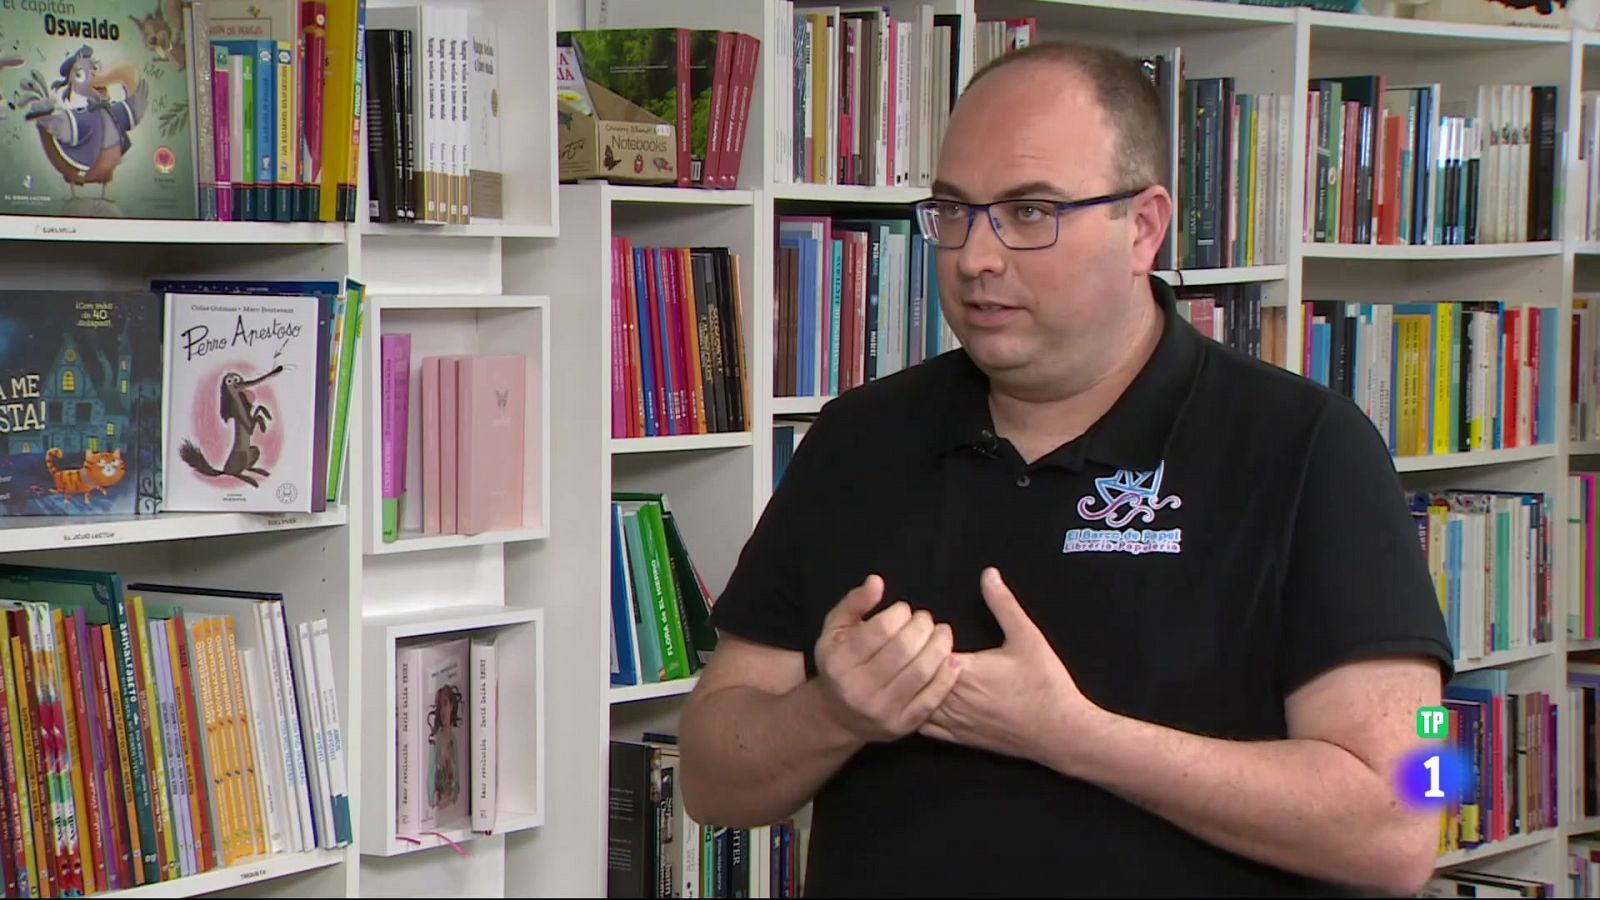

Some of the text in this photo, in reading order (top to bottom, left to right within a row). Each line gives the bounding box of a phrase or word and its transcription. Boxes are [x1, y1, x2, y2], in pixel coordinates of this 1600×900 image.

[3, 0, 75, 14] El capitán
[44, 14, 119, 40] Oswaldo
[611, 135, 668, 153] Notebooks
[93, 309, 108, 320] 40
[181, 314, 302, 361] Perro Apestoso
[11, 375, 40, 399] ME
[1067, 529, 1181, 542] El Barco de Papel
[650, 558, 674, 656] FLORA de EL HIERRO
